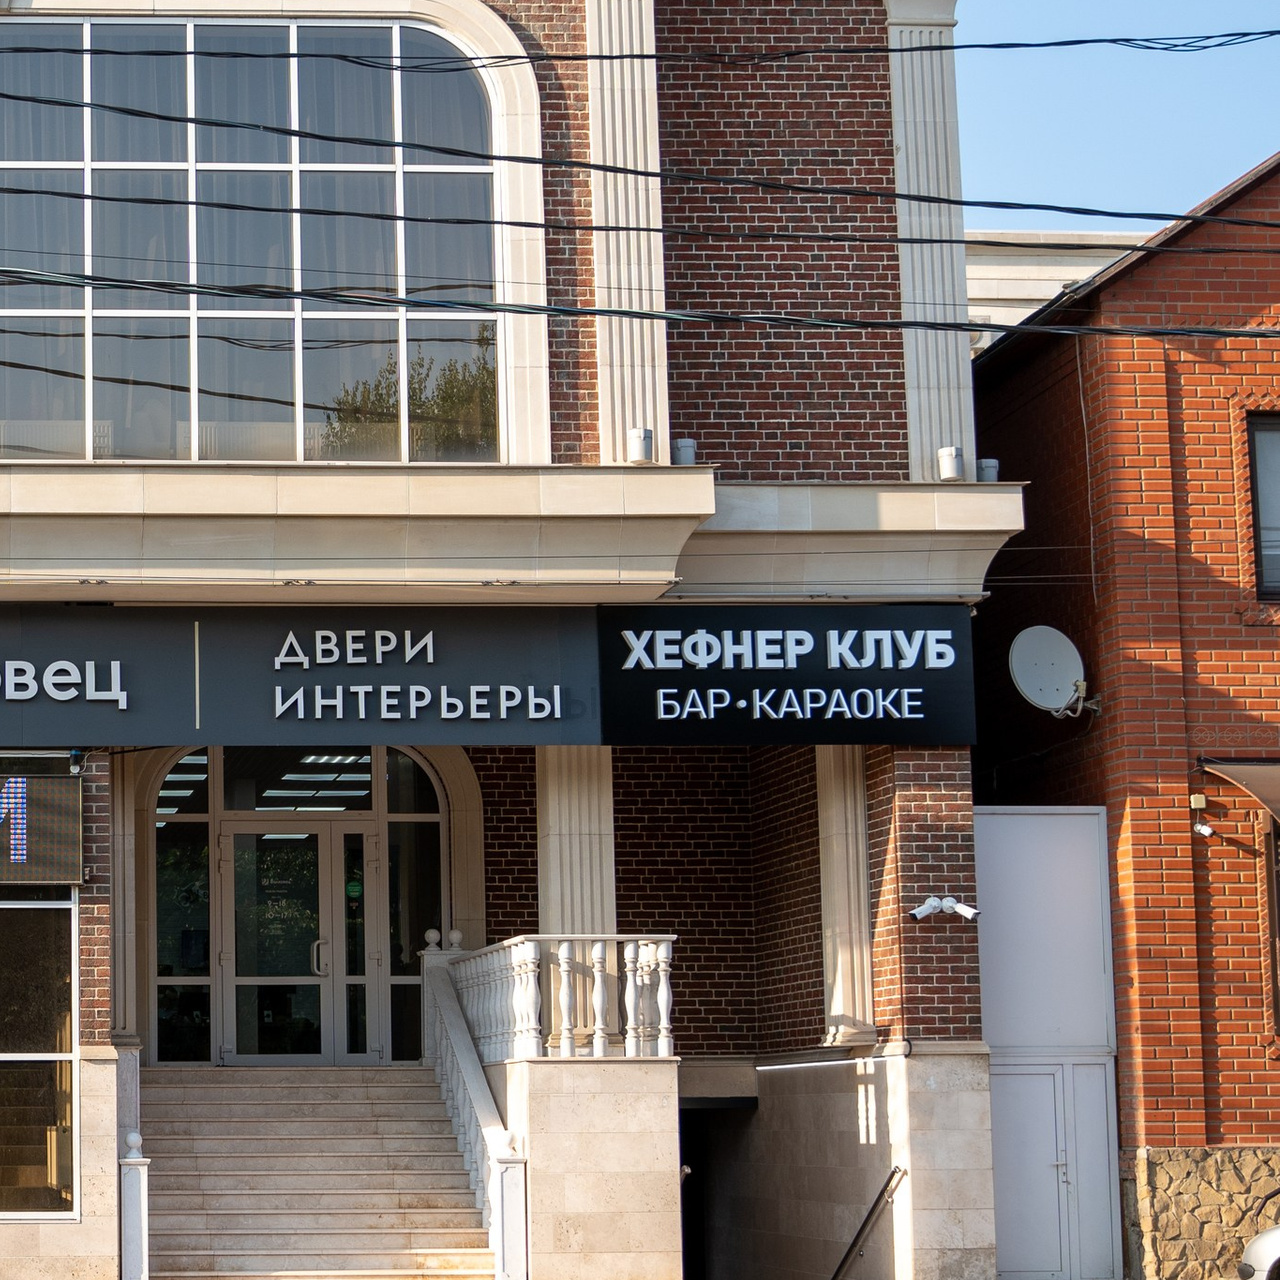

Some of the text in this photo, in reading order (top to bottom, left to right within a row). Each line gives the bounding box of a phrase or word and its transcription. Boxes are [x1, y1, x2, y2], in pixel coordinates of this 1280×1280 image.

[274, 630, 434, 670] ДВЕРИ
[621, 629, 956, 670] ХЕФНЕР КЛУБ
[275, 684, 561, 720] ИНТЕРЬЕРЫ
